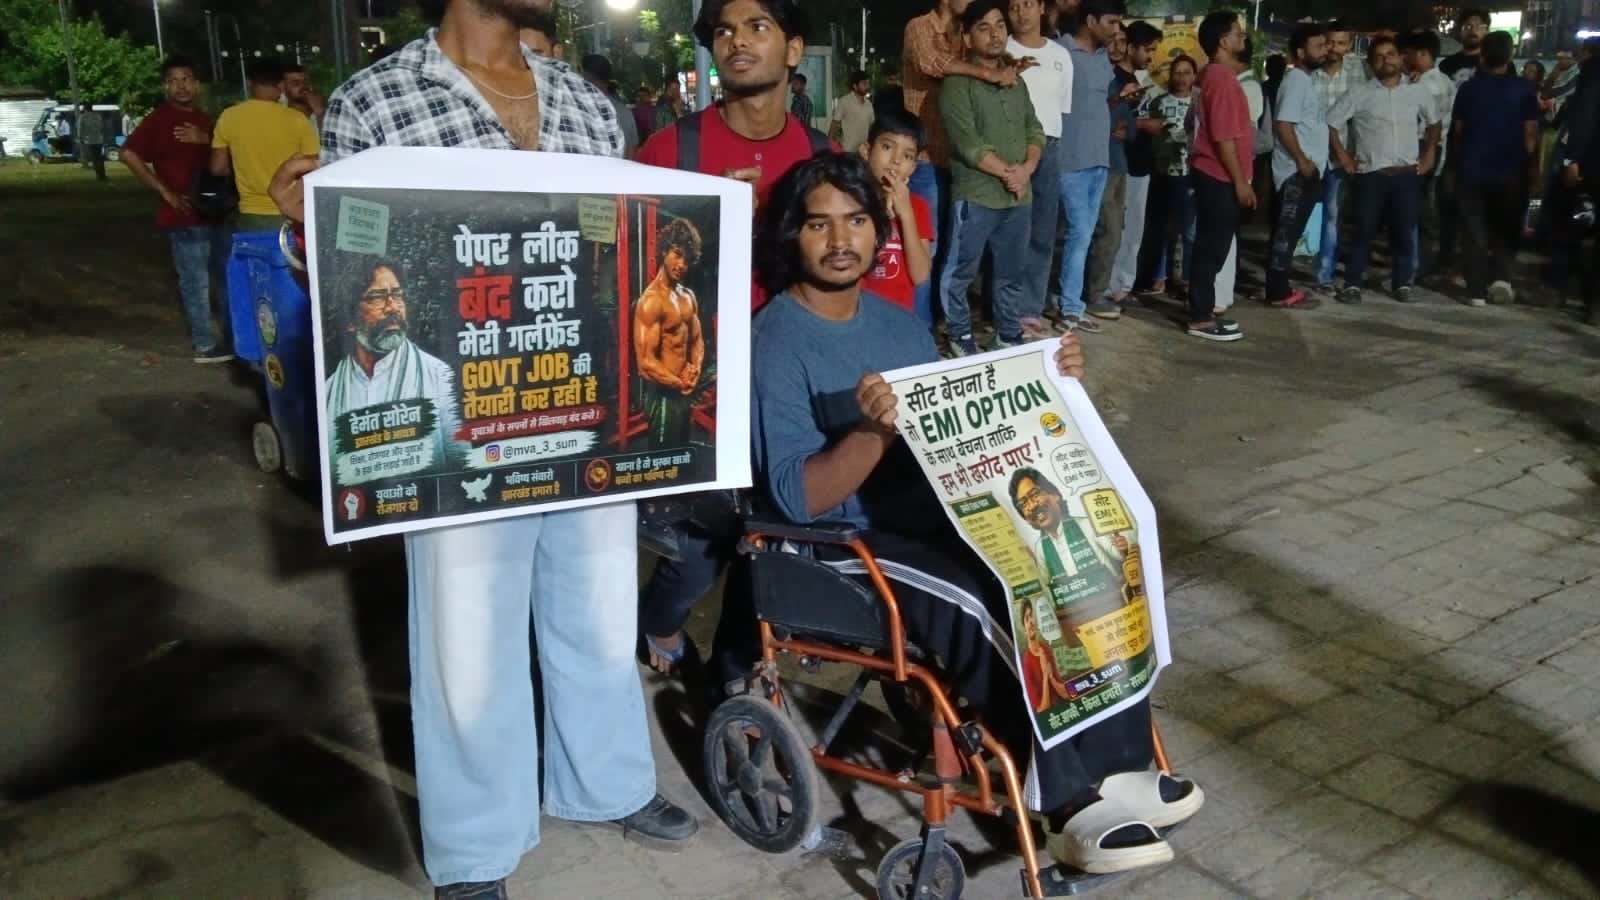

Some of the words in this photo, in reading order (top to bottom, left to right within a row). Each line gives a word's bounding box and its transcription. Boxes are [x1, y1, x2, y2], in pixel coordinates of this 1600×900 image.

[453, 224, 512, 267] पेपर
[521, 221, 580, 264] लीक
[456, 265, 513, 322] बंद
[522, 265, 577, 311] करो
[457, 320, 500, 356] मेरी
[506, 313, 581, 352] गर्लफ्रेंड
[462, 357, 522, 390] GOVT
[527, 352, 569, 383] JOB
[573, 352, 592, 375] की
[905, 383, 939, 413] सीट
[940, 372, 983, 401] बेचना
[985, 363, 996, 391] है
[349, 410, 380, 435] हेमंत
[382, 403, 421, 428] सोरेन
[463, 386, 516, 420] तैयारी
[520, 387, 550, 412] कर
[553, 377, 582, 406] रही
[585, 375, 598, 403] है
[918, 405, 963, 444] EMI
[965, 380, 1052, 429] OPTION
[503, 439, 578, 459] @mva_3_sum
[955, 435, 987, 458] बेचना
[987, 423, 1017, 448] ताकि
[938, 473, 958, 497] हम
[954, 462, 972, 489] भी
[969, 454, 1006, 484] खरीद
[1002, 442, 1034, 468] पाए
[1033, 435, 1044, 458] !
[1093, 493, 1112, 506] सीट
